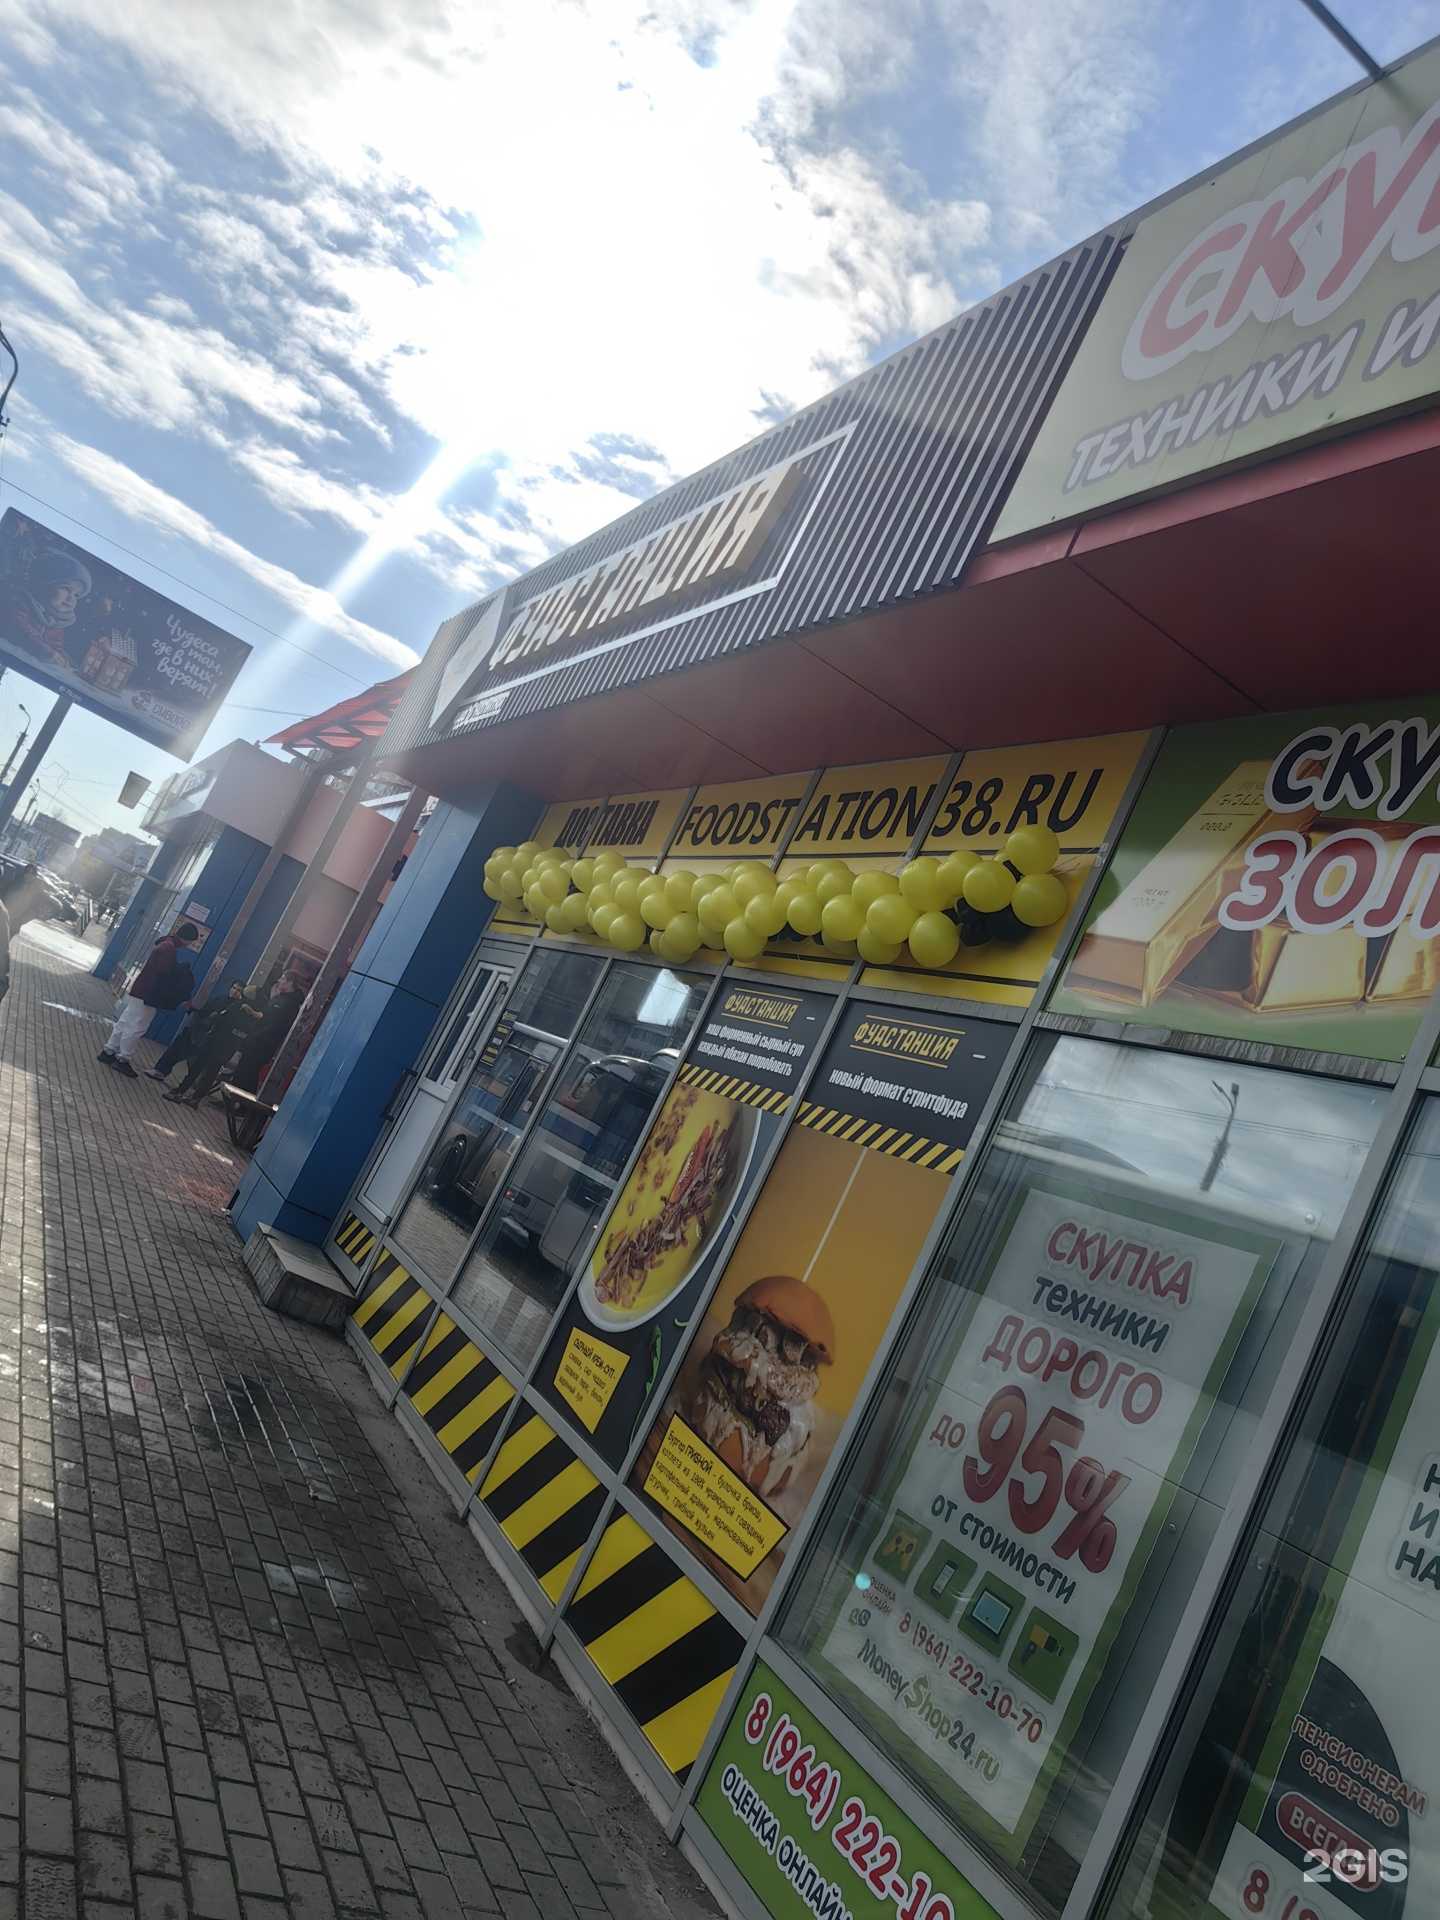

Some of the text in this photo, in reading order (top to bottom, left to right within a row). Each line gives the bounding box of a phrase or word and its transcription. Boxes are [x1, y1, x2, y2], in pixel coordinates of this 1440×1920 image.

[1065, 324, 1362, 492] ТЕХНИКИ
[151, 638, 173, 656] где
[165, 614, 219, 658] Чудеса
[854, 1022, 960, 1060] ФУДСТАНЦИЯ
[829, 1068, 968, 1120] новый формат стритфуда
[1046, 1221, 1195, 1306] СКУПКА
[981, 1313, 1164, 1425] ДОРОГО
[963, 1384, 1131, 1574] 95%
[898, 1611, 1043, 1744] 8 (964) 222-10-70
[745, 1694, 772, 1742] 8
[764, 1718, 839, 1826] (964)
[1292, 1714, 1427, 1818] ПЕНСИОНЕРАМ
[1299, 1749, 1400, 1827] ОДОБРЕНО
[721, 1765, 780, 1854] ОЦЕНКА
